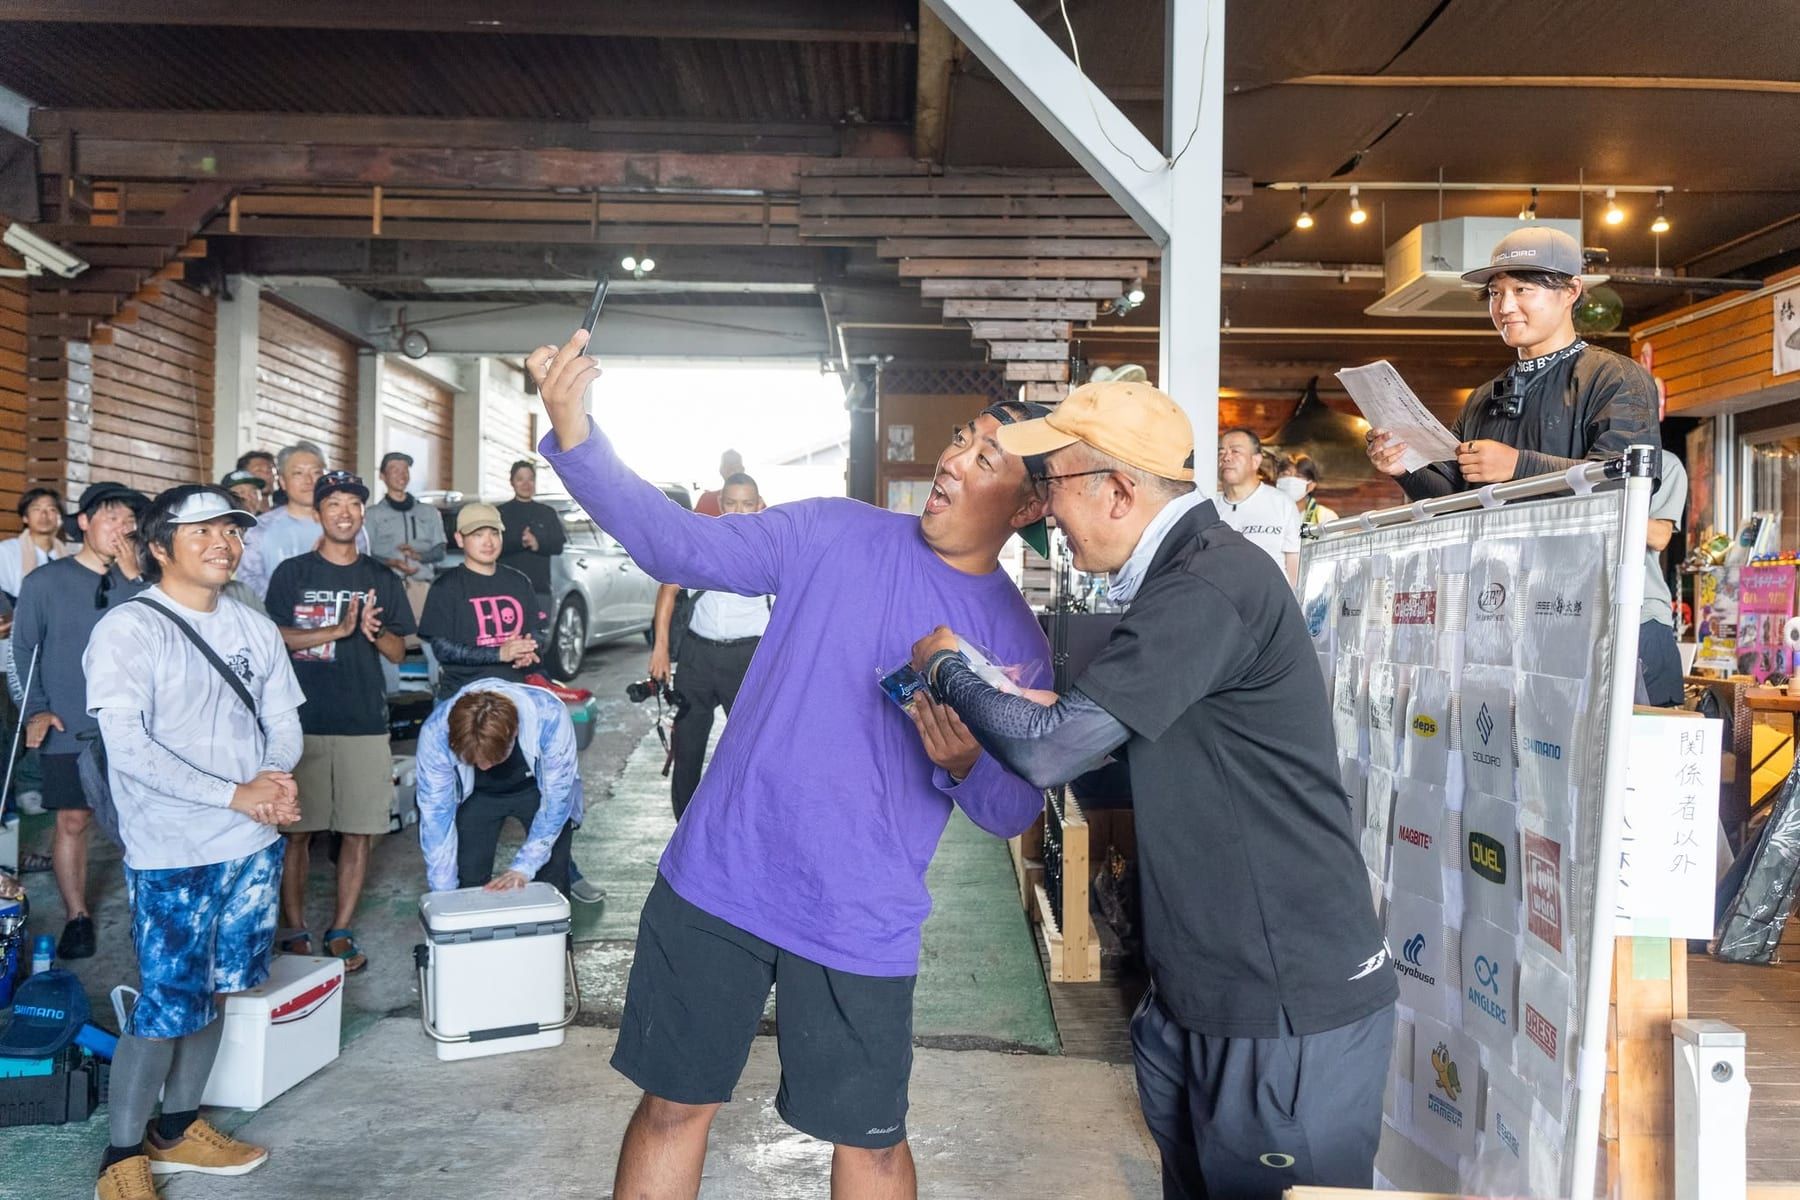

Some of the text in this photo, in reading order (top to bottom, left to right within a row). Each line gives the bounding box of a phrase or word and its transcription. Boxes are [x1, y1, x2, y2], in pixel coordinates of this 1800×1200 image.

[1242, 525, 1283, 535] ZELOS
[1413, 718, 1436, 733] deps
[1669, 729, 1705, 875] 関係者以外
[1471, 841, 1502, 873] DUEL
[1393, 959, 1435, 985] Hayabusa
[14, 1004, 65, 1020] SHIMANO
[1468, 987, 1506, 1025] ANGLERS
[1526, 1007, 1557, 1049] DRESS
[1428, 1100, 1463, 1129] KAMEYA
